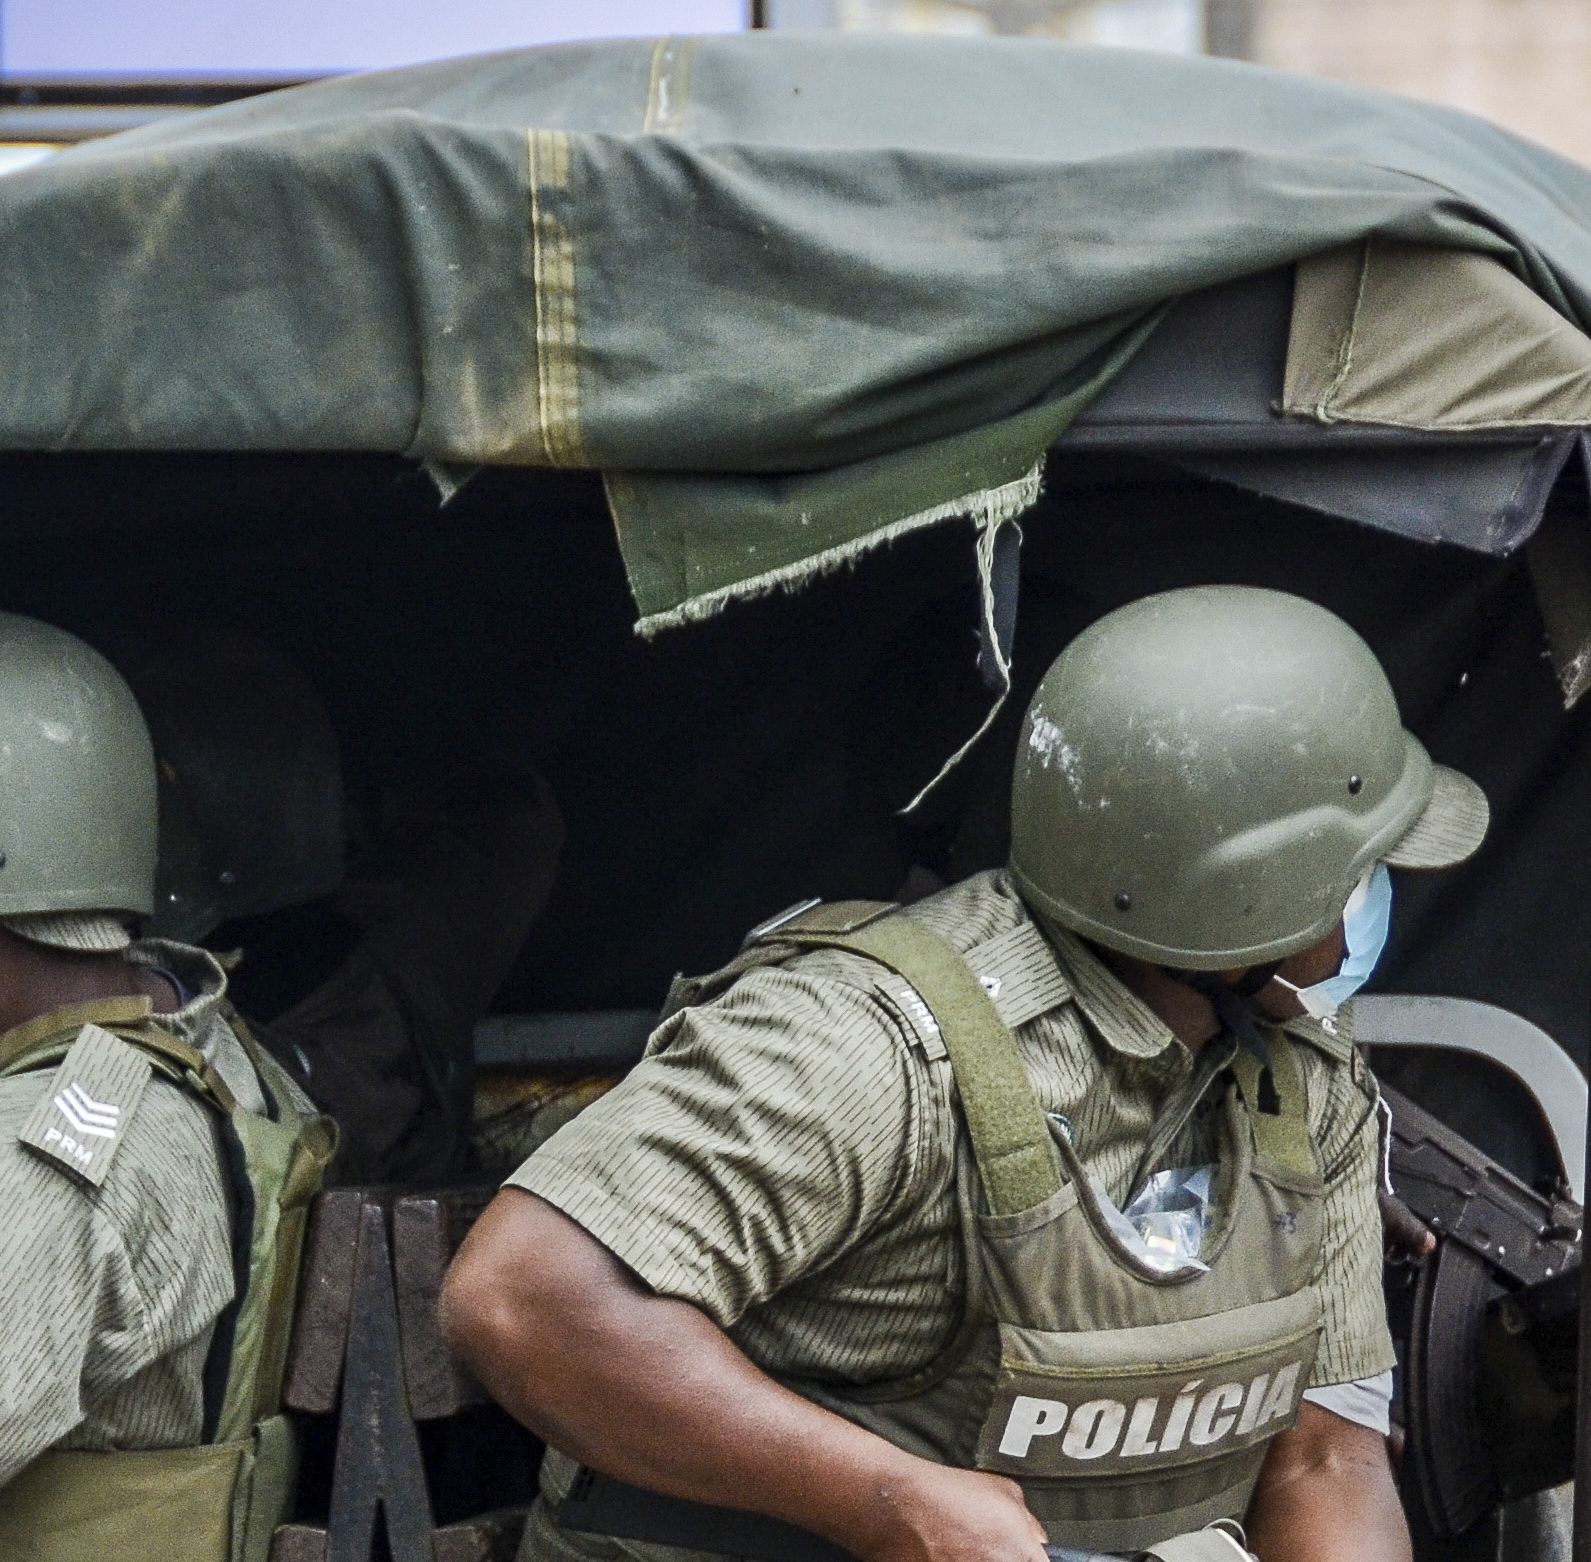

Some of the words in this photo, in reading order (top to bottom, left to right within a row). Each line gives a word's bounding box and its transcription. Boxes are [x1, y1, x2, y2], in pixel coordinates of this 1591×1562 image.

[900, 989, 939, 1033] PRM
[44, 1127, 93, 1165] PRM
[998, 1360, 1302, 1459] POLÍCIA
